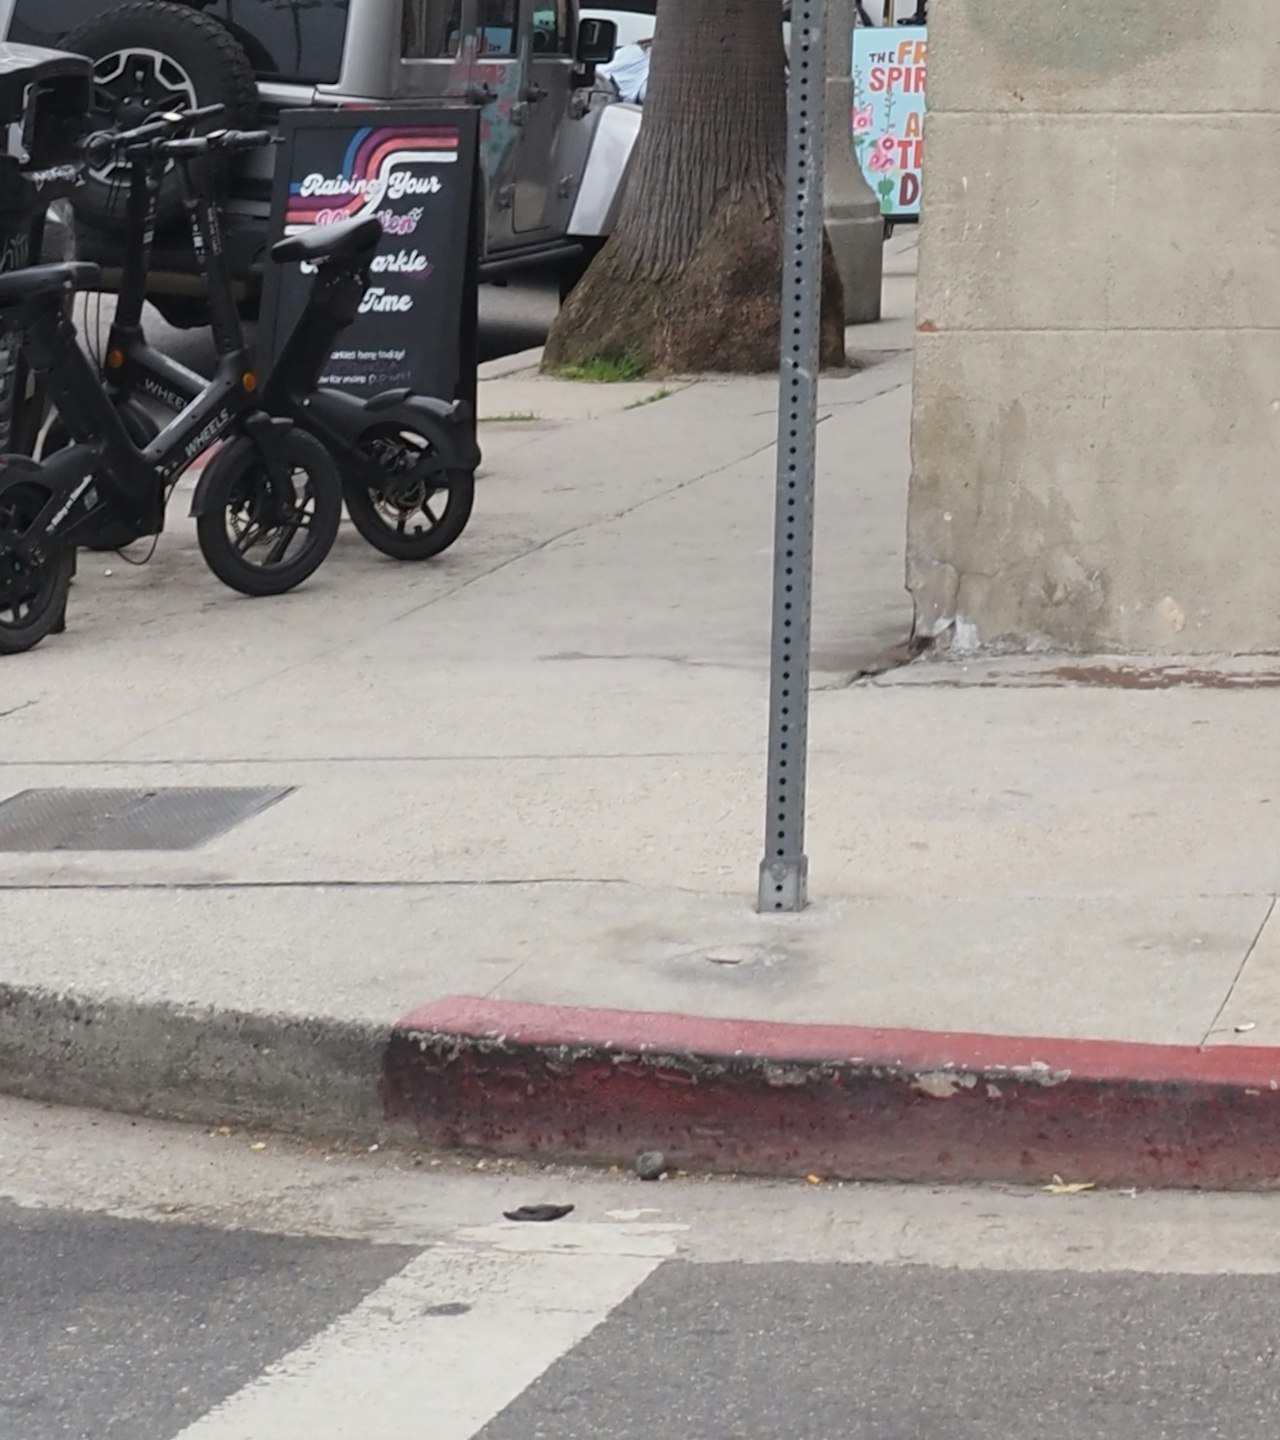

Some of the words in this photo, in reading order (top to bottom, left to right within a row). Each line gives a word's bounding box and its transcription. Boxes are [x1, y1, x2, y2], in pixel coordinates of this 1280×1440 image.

[869, 52, 895, 64] THE
[300, 173, 381, 201] Raising
[387, 171, 442, 199] Your
[358, 286, 414, 314] Time
[185, 407, 229, 457] WHEELS
